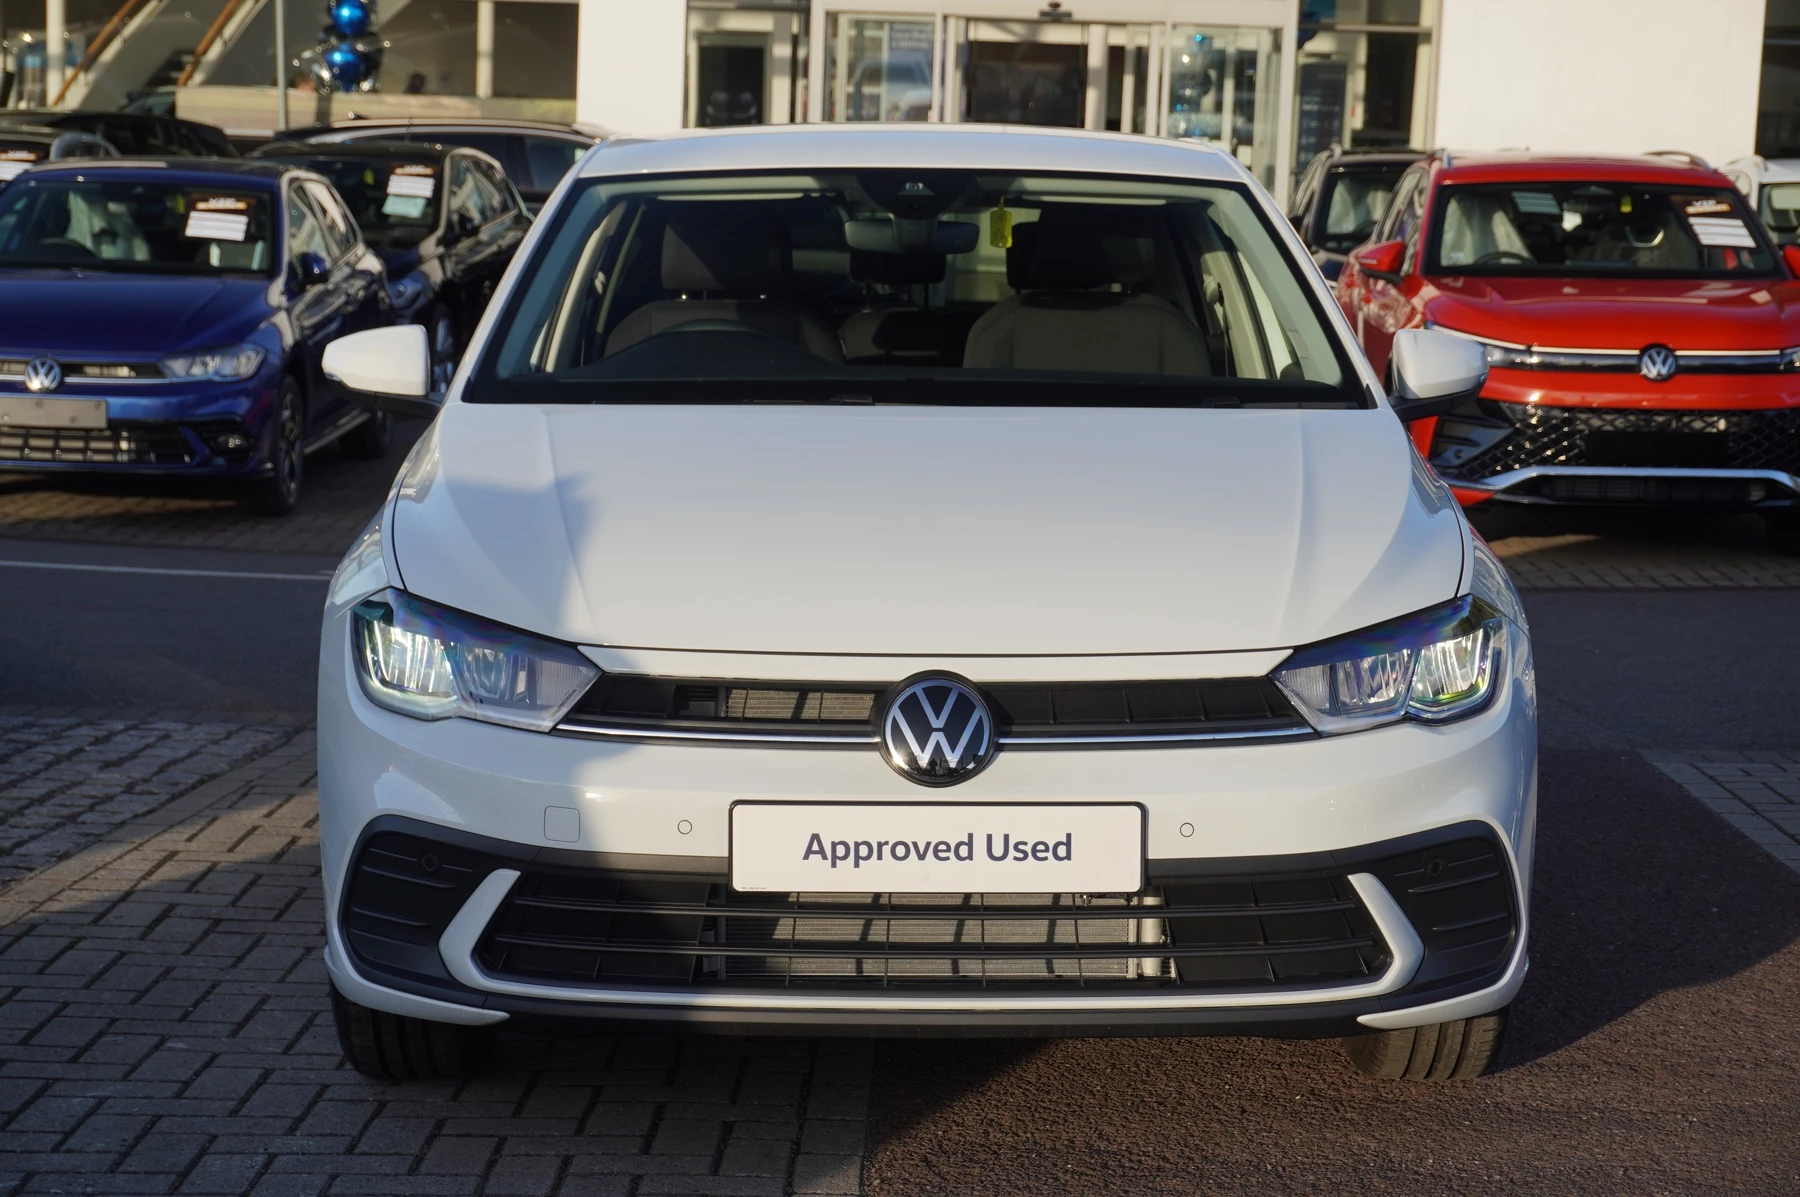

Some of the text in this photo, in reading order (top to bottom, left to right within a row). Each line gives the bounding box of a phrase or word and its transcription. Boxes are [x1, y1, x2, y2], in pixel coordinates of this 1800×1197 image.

[887, 682, 988, 776] VW
[801, 832, 1072, 869] Approved Used
